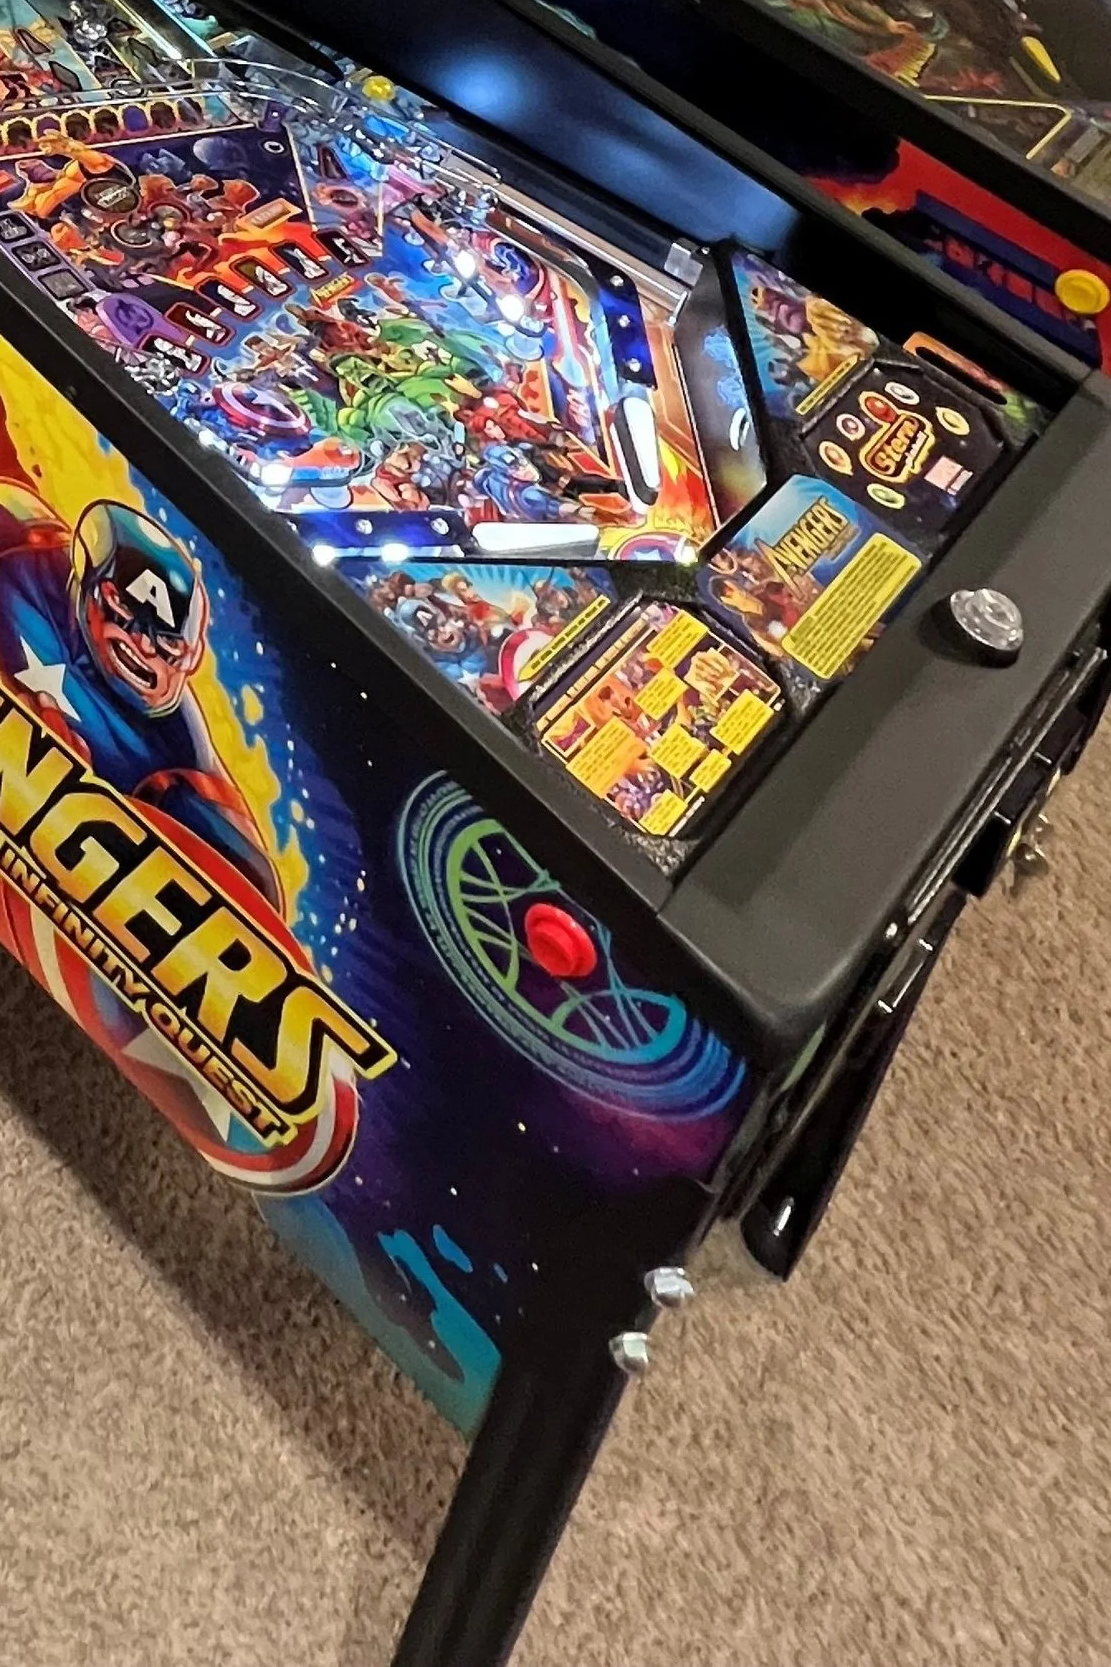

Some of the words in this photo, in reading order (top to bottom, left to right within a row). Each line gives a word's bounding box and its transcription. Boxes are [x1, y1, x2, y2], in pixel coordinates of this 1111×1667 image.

[873, 417, 917, 476] Stern
[754, 495, 850, 601] AVENGERS
[125, 568, 176, 629] A
[0, 848, 149, 998] INFINITY
[150, 1004, 285, 1132] QUEST
